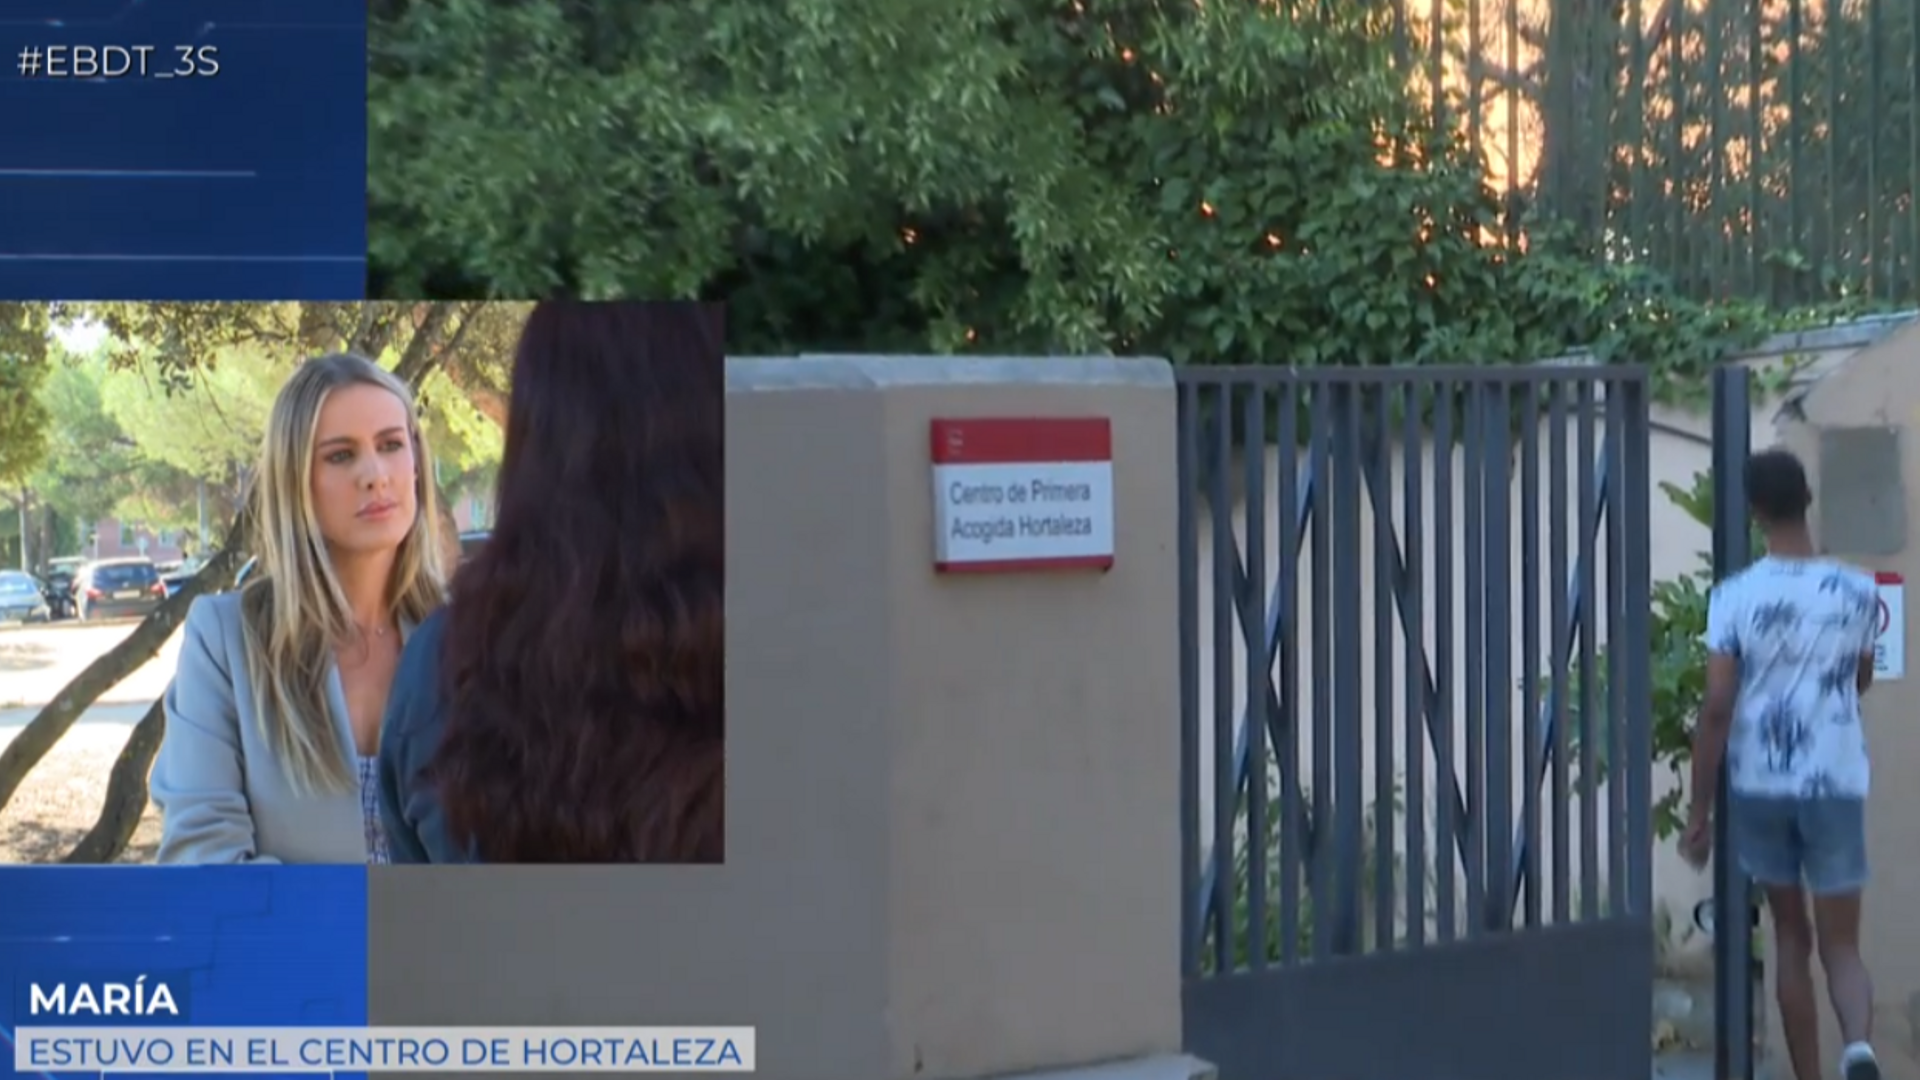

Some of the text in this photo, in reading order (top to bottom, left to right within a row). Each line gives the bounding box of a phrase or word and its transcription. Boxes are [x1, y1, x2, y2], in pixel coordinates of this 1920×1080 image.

[950, 479, 1091, 504] Centro de Primera
[951, 514, 1092, 544] Acogida Hortaleza
